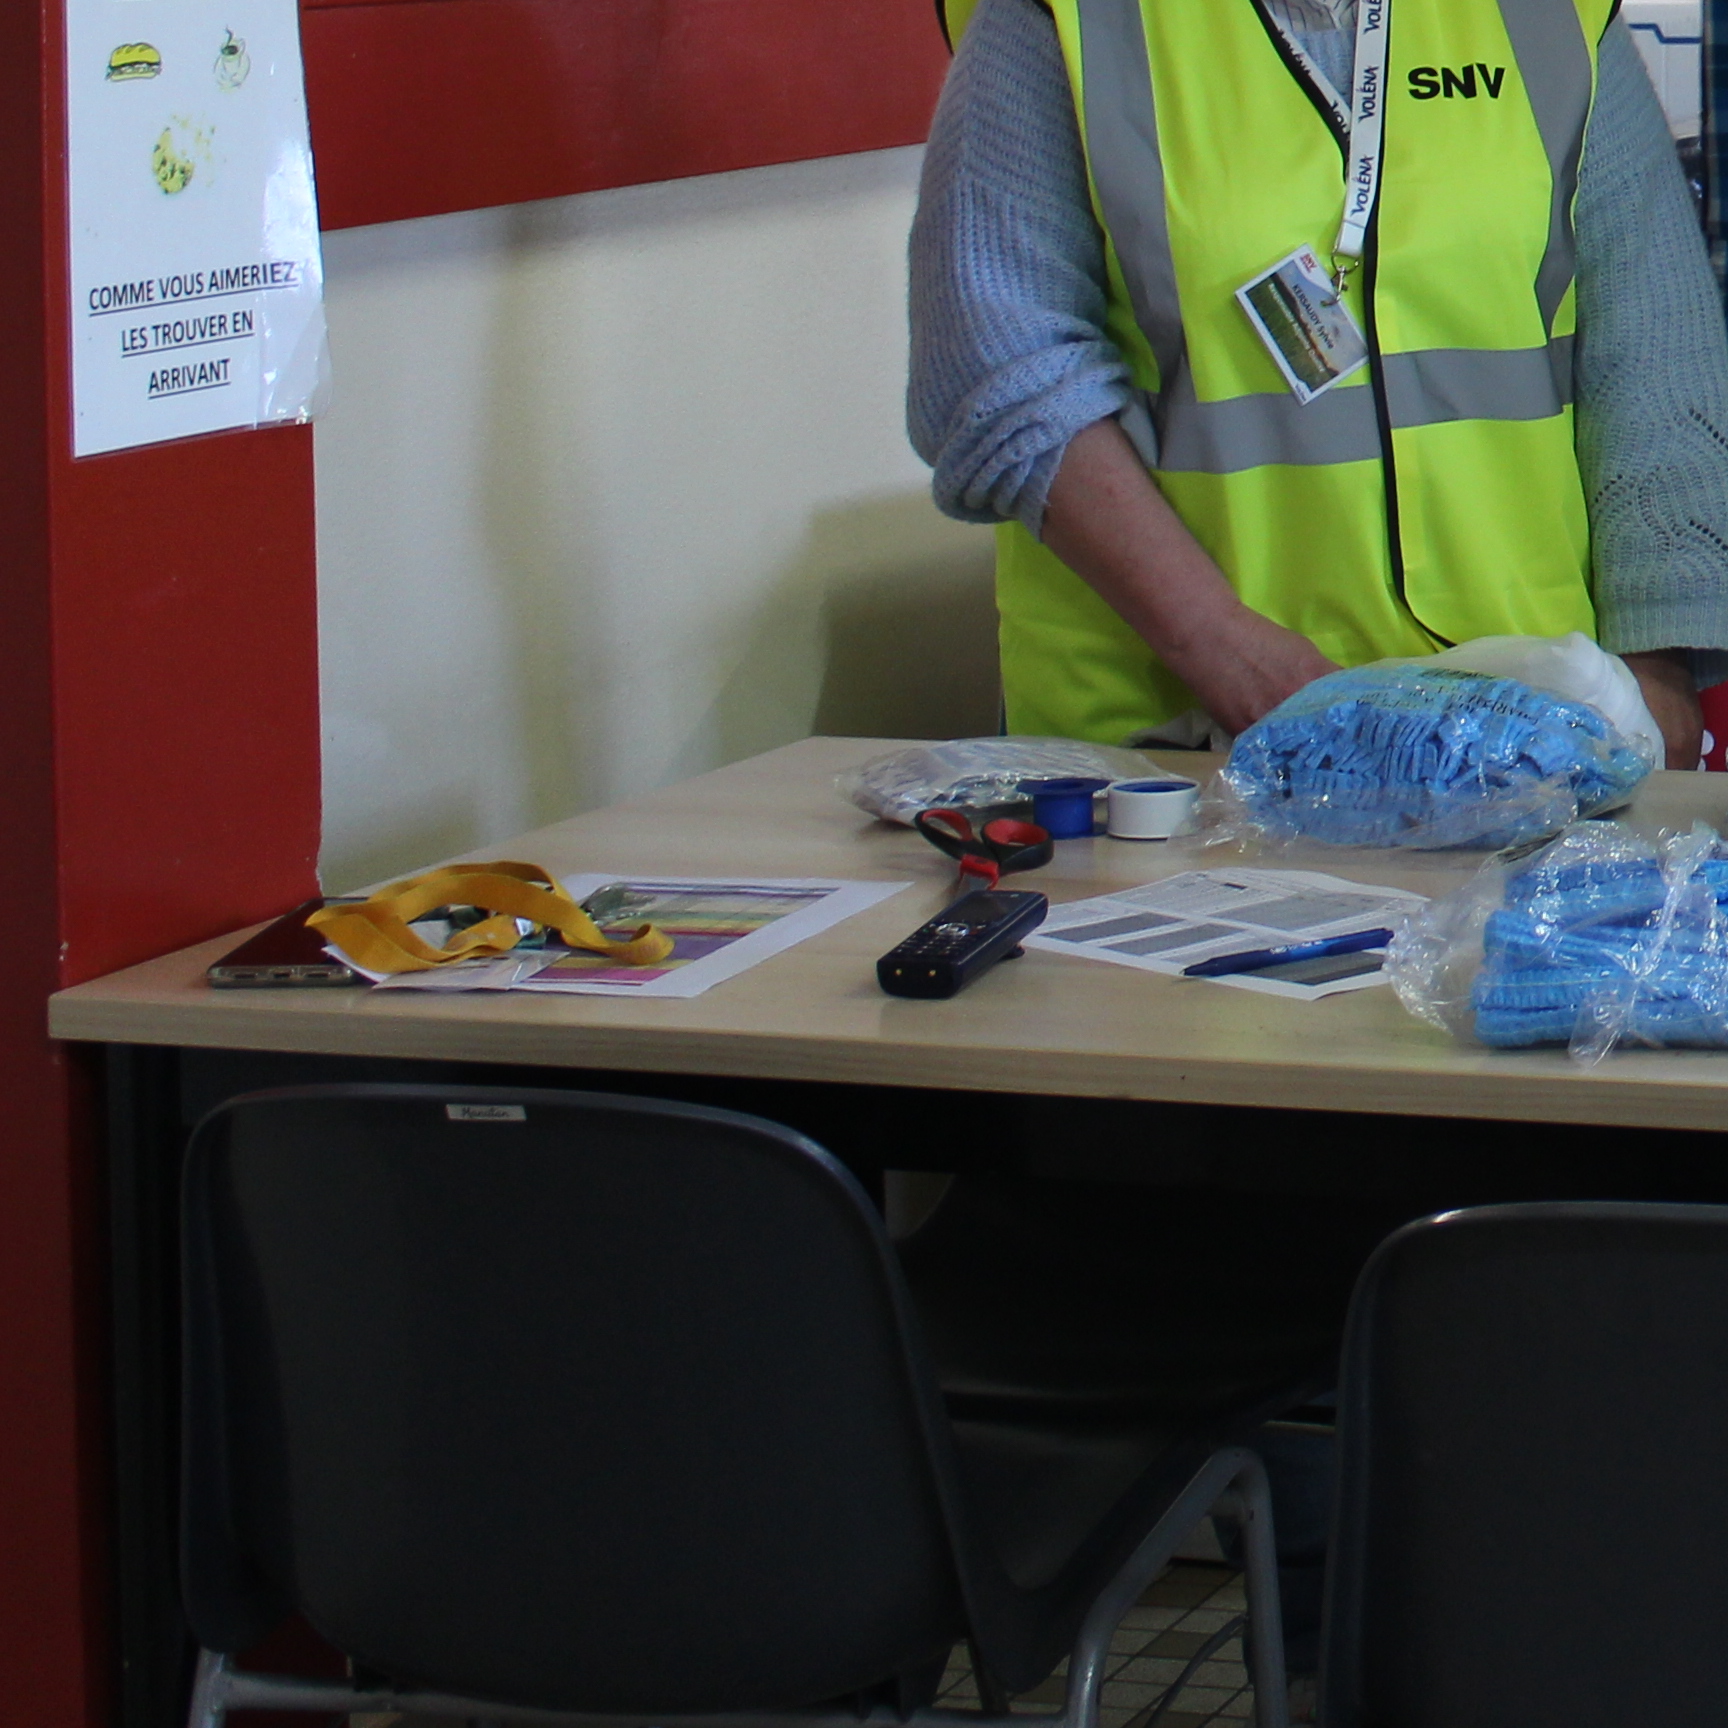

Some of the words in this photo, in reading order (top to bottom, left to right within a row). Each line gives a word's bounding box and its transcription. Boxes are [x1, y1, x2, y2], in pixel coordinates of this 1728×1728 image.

[1407, 63, 1506, 101] SNV
[89, 279, 154, 312] COMME
[157, 272, 204, 300] VOUS
[208, 260, 297, 293] AIMERIEZ
[1292, 283, 1320, 327] KERSAUDY
[121, 325, 149, 352] LES
[151, 315, 228, 345] TROUVER
[231, 310, 254, 335] EN
[148, 358, 230, 393] ARRIVANT
